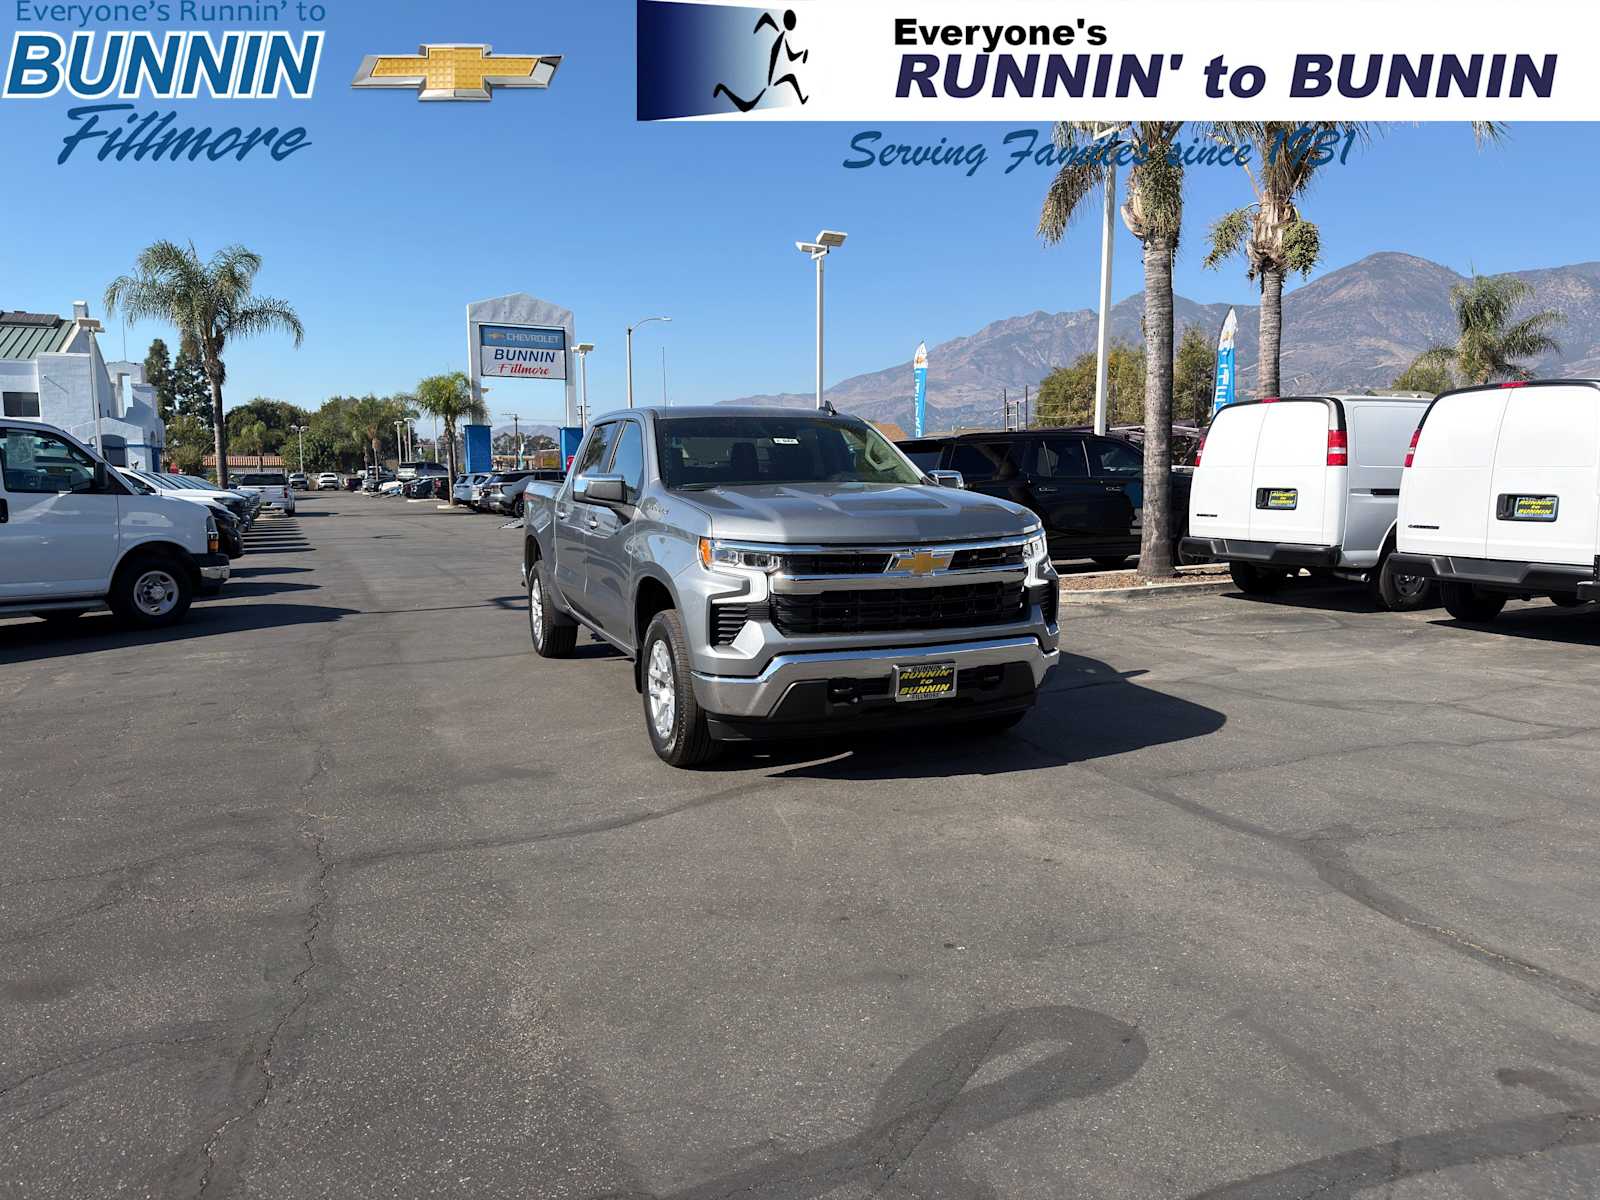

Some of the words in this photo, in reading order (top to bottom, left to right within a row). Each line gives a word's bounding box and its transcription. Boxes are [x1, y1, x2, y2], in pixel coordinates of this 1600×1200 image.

[506, 332, 559, 343] CHEVROLET
[494, 348, 556, 362] BUNNIN
[497, 363, 550, 375] Fillmore
[900, 683, 950, 694] BUNNIN
